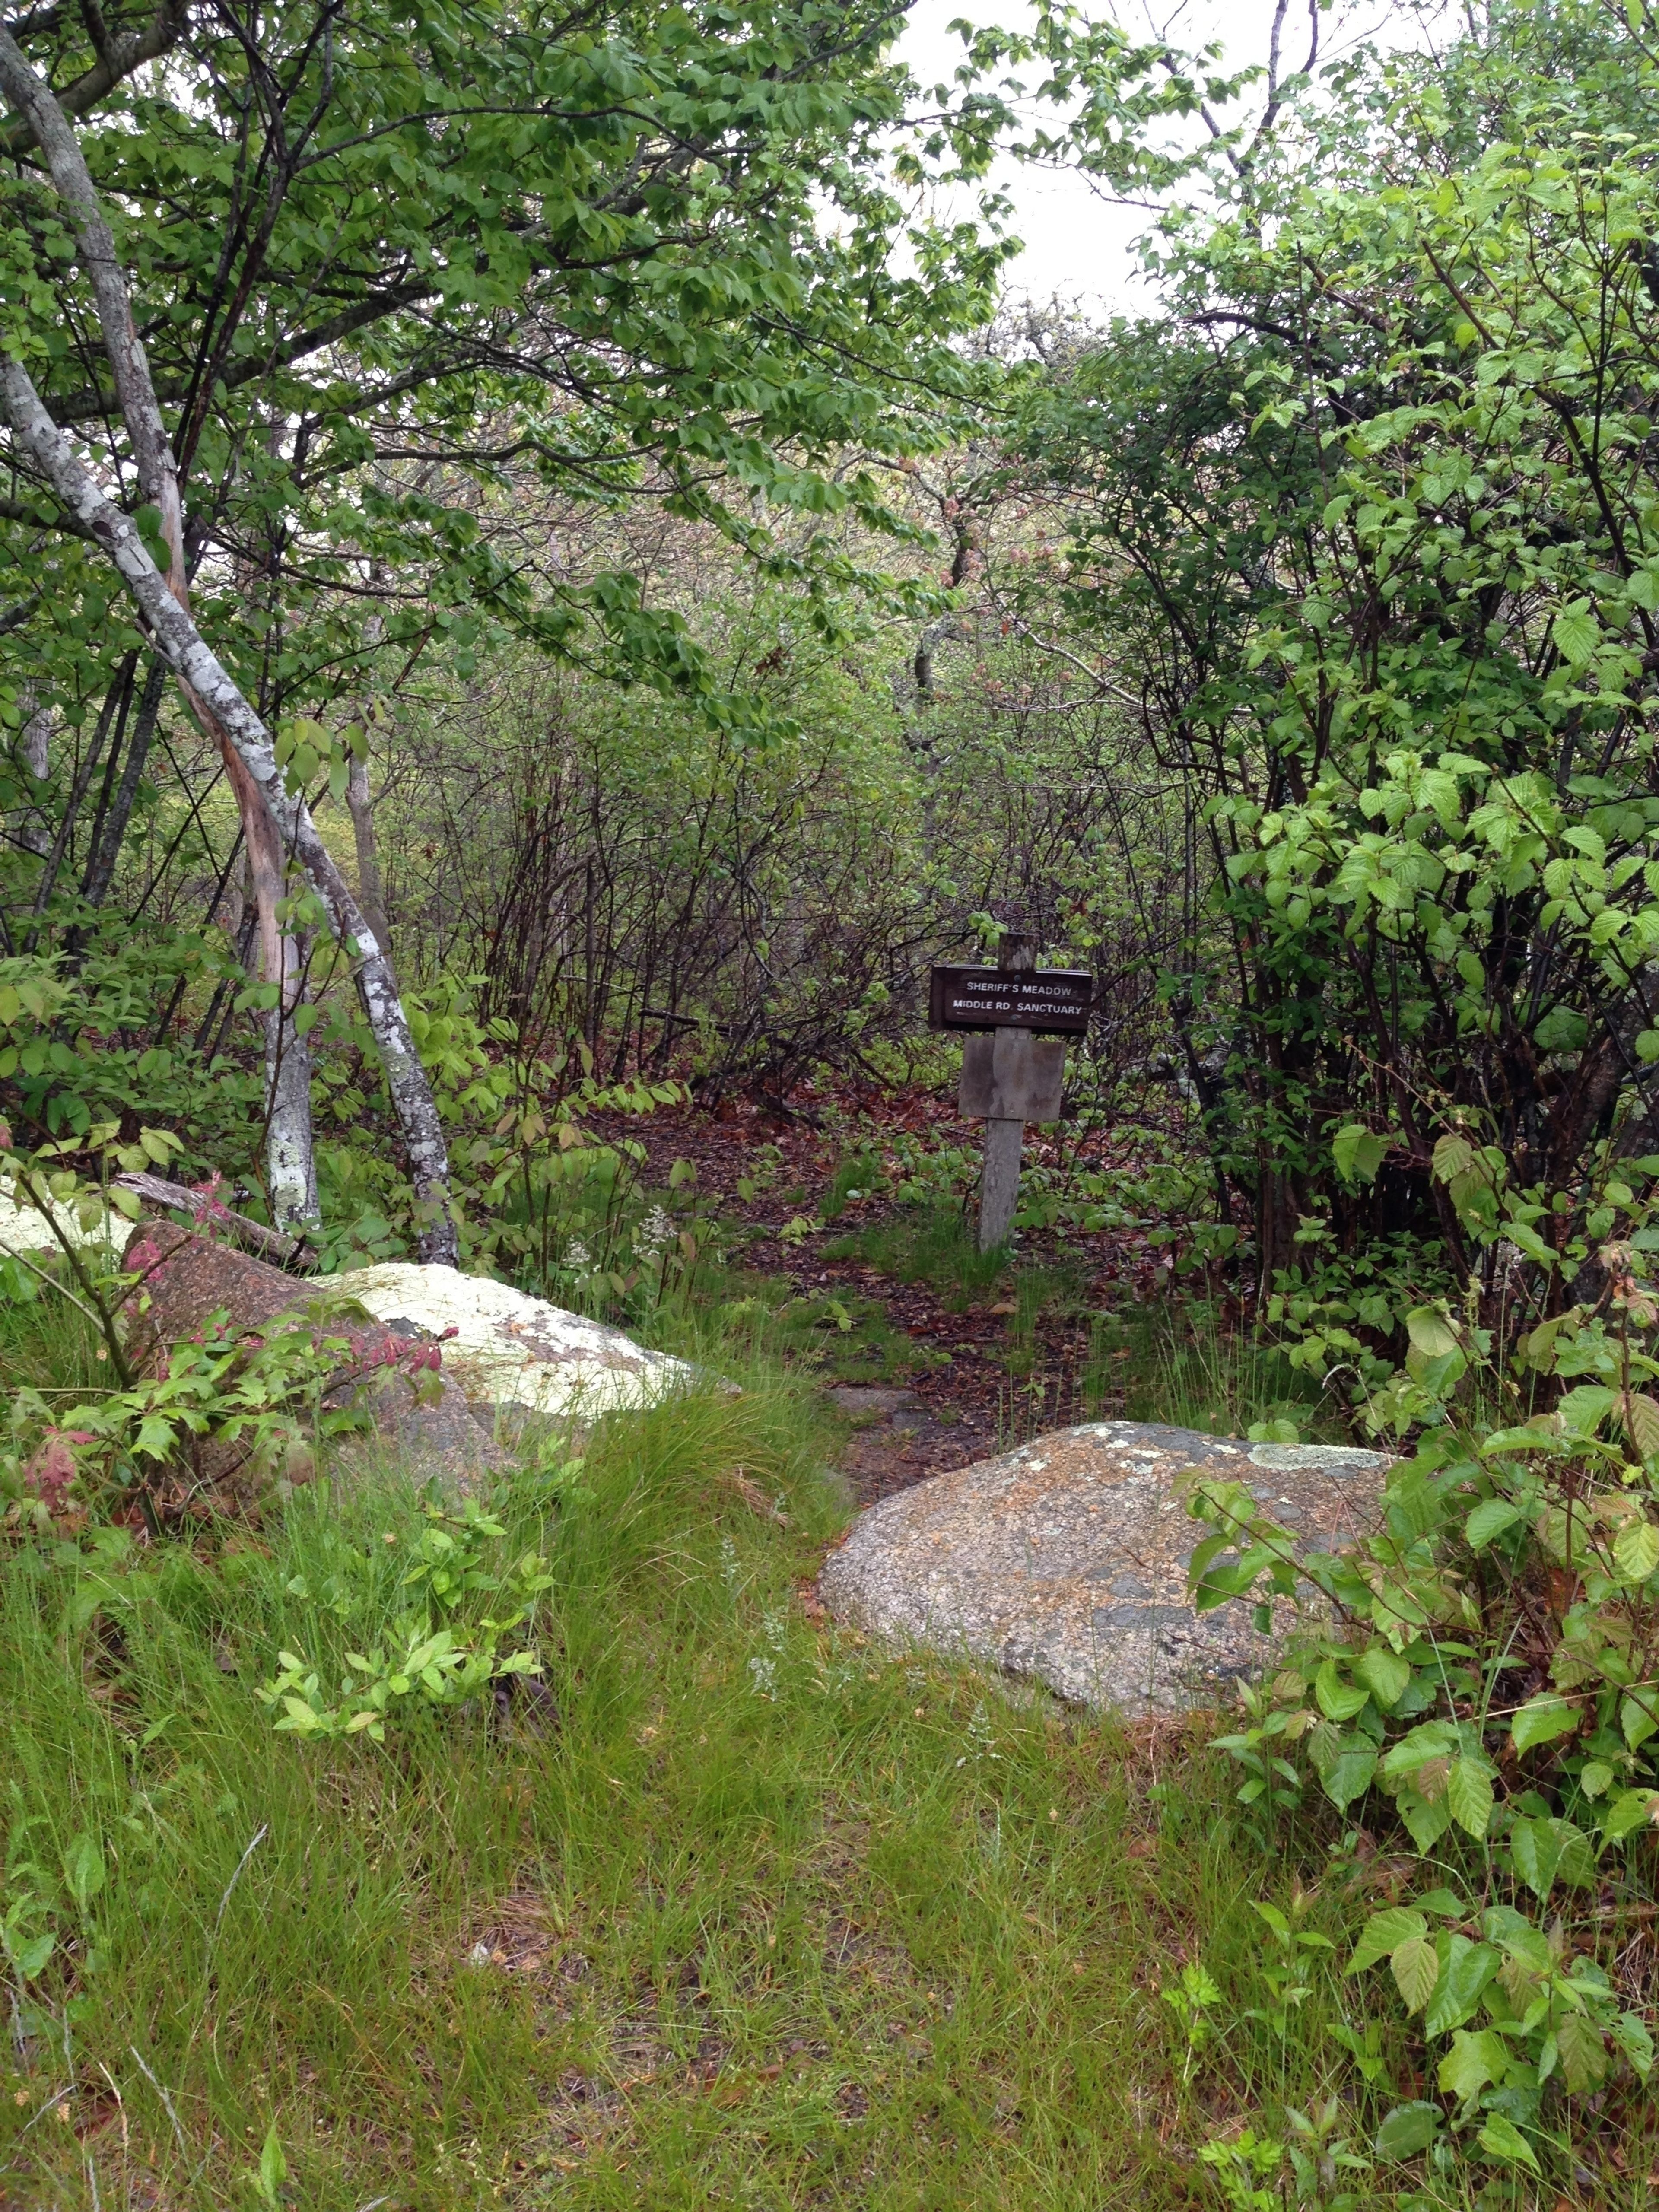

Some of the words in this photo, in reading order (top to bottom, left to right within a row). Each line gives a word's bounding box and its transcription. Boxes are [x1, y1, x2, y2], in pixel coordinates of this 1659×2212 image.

[967, 982, 1019, 993] SHERIFF'S
[1022, 985, 1071, 996] MEADOW
[953, 1000, 992, 1010] MIDDLE
[1017, 1003, 1081, 1014] SANCTUARY
